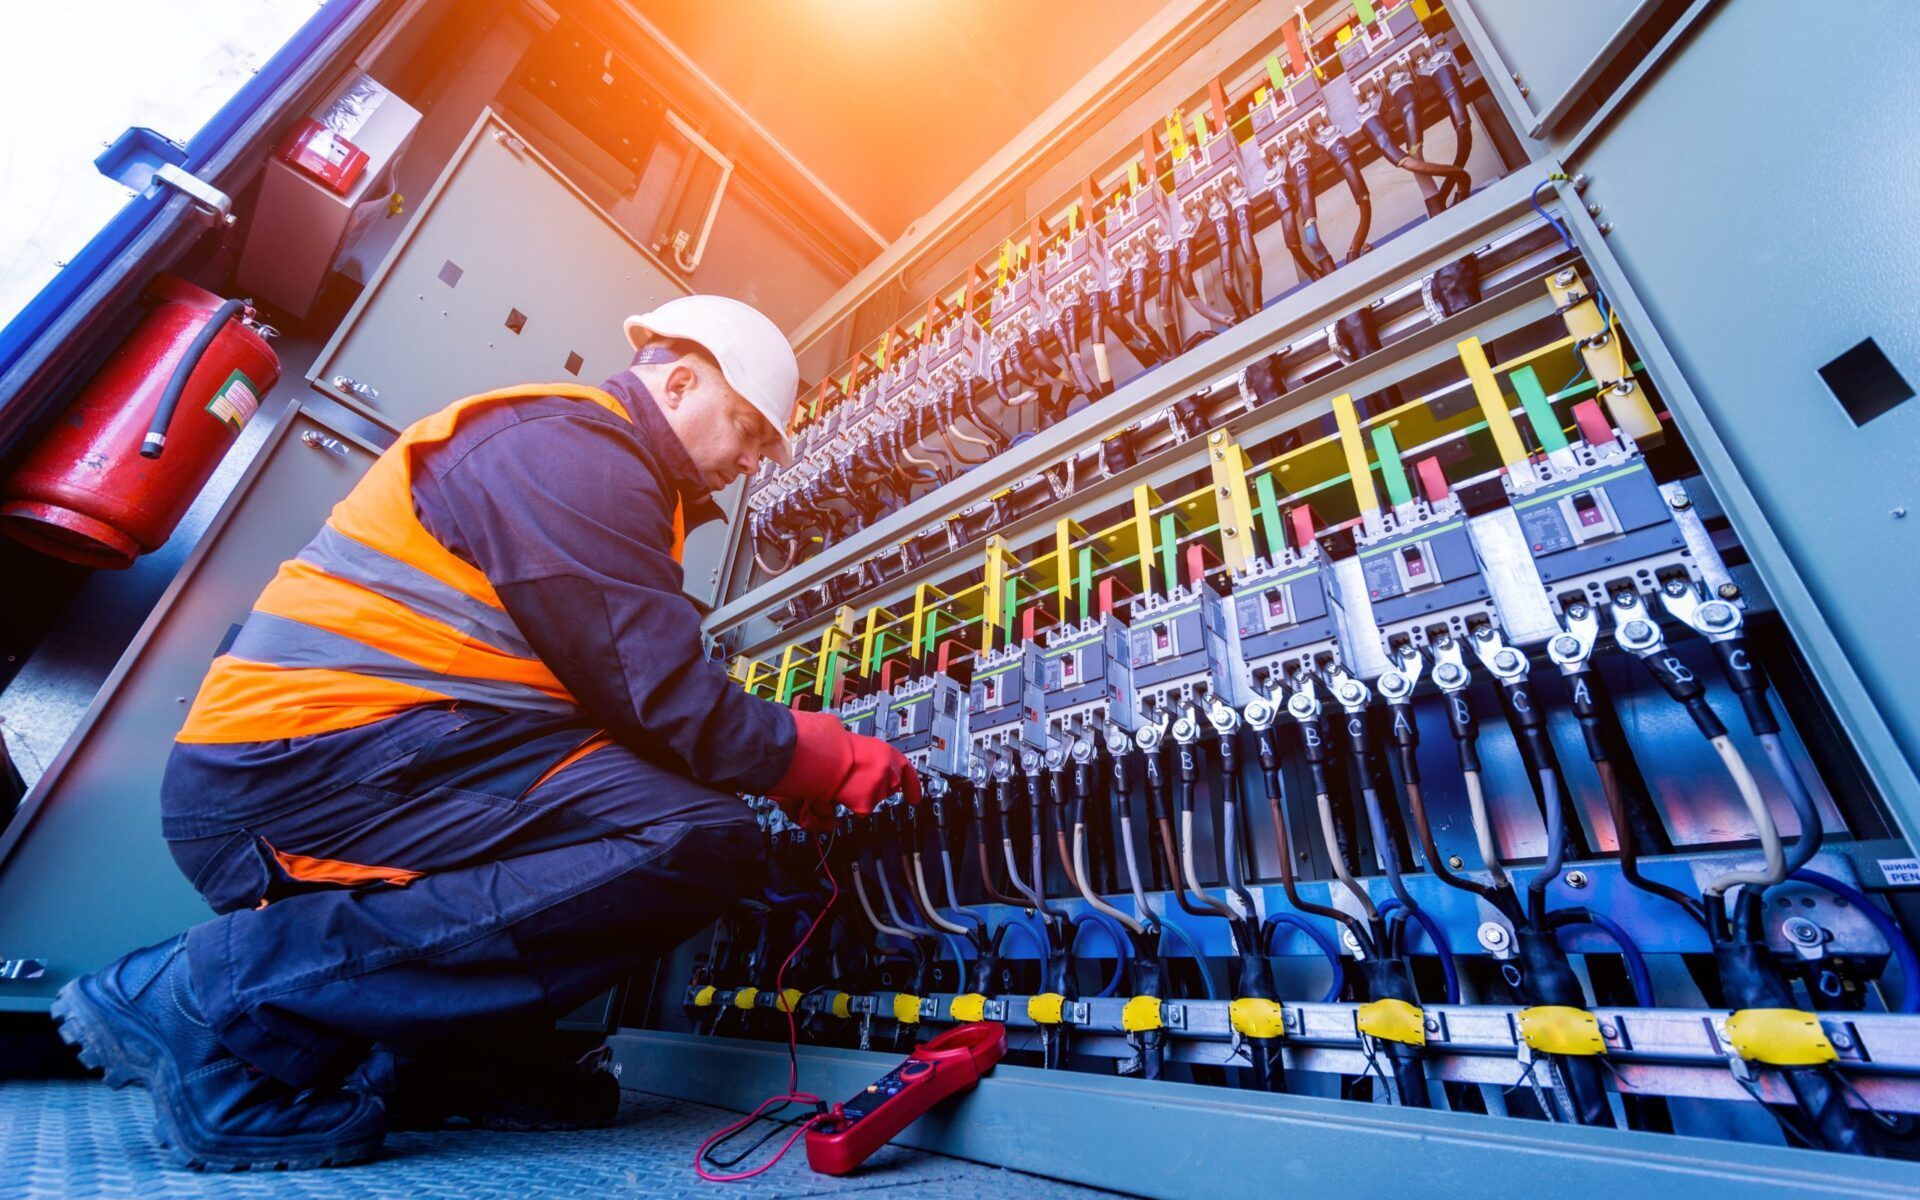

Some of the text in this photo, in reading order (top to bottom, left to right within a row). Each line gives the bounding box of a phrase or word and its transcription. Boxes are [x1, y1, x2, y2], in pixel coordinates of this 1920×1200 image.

[1336, 144, 1346, 154] C
[1296, 163, 1308, 177] B
[1276, 189, 1288, 204] A
[1237, 209, 1246, 222] C
[1217, 223, 1227, 236] B
[1178, 242, 1190, 257] A
[1729, 649, 1752, 671] C
[1663, 657, 1694, 684] B
[1574, 678, 1592, 705] A
[1512, 690, 1530, 713] C
[1453, 698, 1470, 724] B
[1347, 718, 1362, 737] C
[1394, 710, 1413, 737] A
[1306, 727, 1321, 747] B
[1221, 742, 1231, 757] C
[1260, 738, 1272, 756] A
[1147, 758, 1158, 778] A
[1181, 751, 1194, 770] B
[1075, 770, 1083, 786] B
[1114, 763, 1122, 778] C
[996, 788, 1003, 801] B
[1027, 782, 1034, 794] C
[1051, 780, 1058, 795] A
[973, 793, 979, 808] A
[933, 802, 941, 816] C
[797, 831, 806, 844] B
[1891, 873, 1920, 882] PEN
